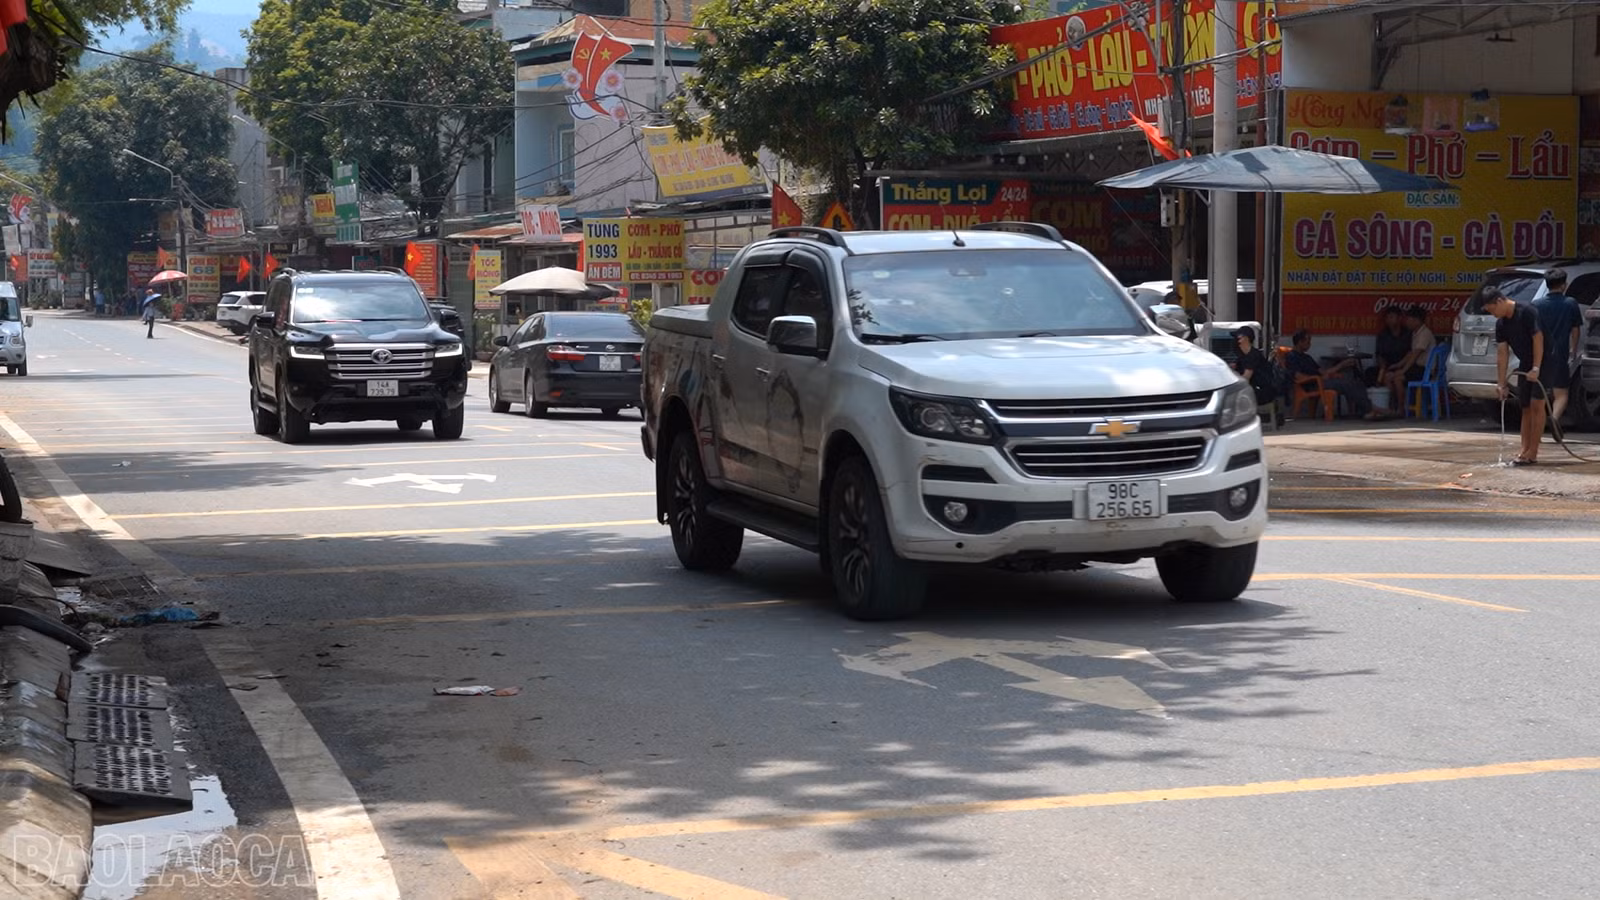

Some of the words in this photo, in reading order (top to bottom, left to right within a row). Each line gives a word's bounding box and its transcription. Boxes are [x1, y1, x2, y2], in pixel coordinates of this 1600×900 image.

[1407, 131, 1467, 185] Phở
[1507, 130, 1571, 180] Lẩu
[891, 181, 951, 205] Thắng
[957, 184, 987, 205] Lợi
[1001, 187, 1027, 201] 24/24
[1407, 193, 1431, 208] ĐẶC
[587, 220, 620, 238] TÙNG
[1296, 211, 1338, 257] CÁ
[1347, 213, 1434, 258] SÔNG
[1464, 213, 1506, 258] GÀ
[1514, 210, 1564, 258] ĐỒI
[588, 244, 618, 258] 1993
[193, 266, 214, 274] 68
[1287, 269, 1319, 286] NHẬN
[1322, 271, 1342, 286] ĐẶT
[1370, 270, 1393, 286] TIỆC
[1397, 270, 1416, 286] HỘI
[1419, 271, 1446, 287] NGHỊ
[1456, 272, 1482, 283] SINH
[1108, 483, 1139, 500] 98C
[1096, 500, 1152, 518] 256.65
